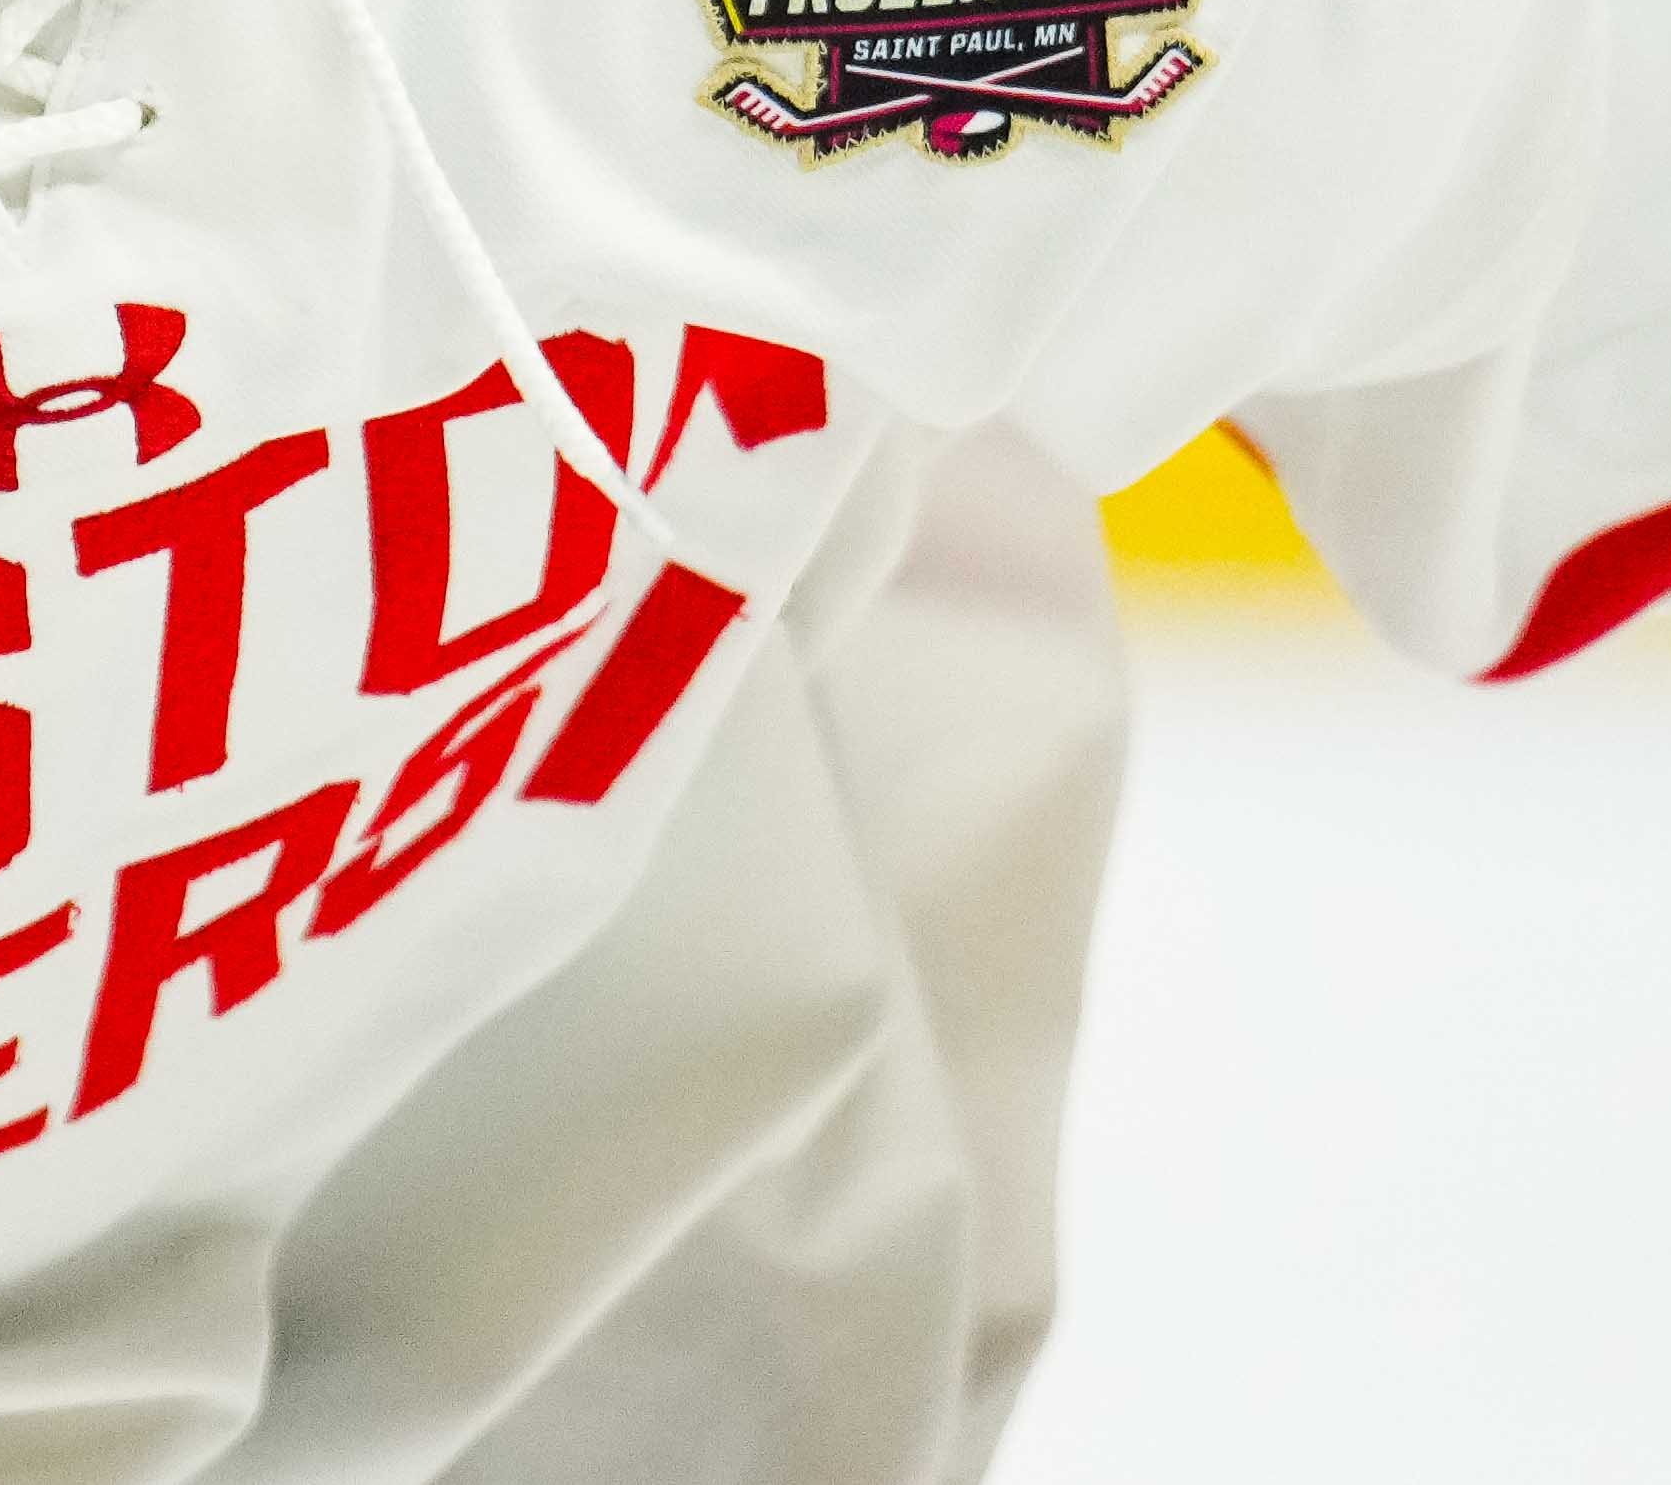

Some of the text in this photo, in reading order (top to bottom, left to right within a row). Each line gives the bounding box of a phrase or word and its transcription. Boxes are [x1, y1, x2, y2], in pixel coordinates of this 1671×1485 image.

[852, 21, 1077, 63] SAINT PAUL, MN
